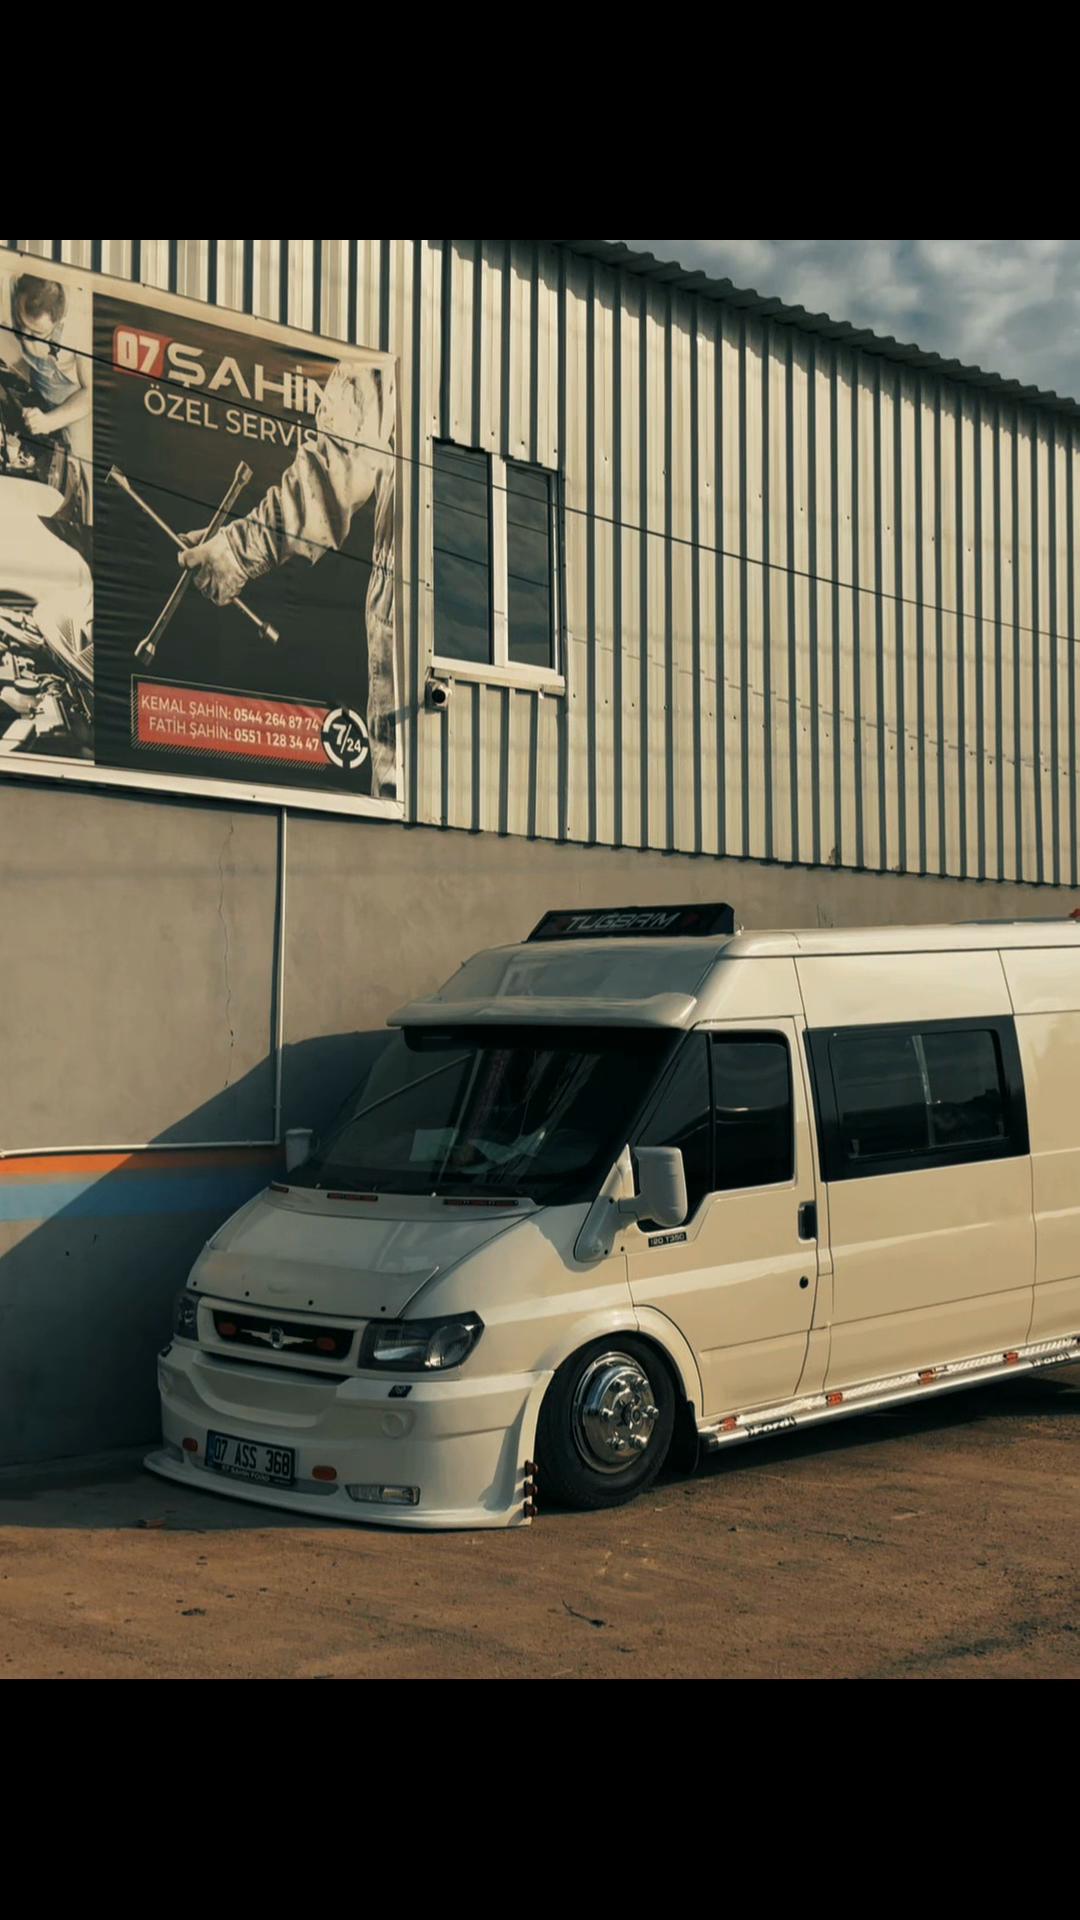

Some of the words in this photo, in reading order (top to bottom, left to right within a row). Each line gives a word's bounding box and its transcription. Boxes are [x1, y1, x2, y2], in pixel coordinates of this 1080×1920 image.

[116, 330, 161, 374] 07
[143, 384, 219, 430] ÖZEL
[141, 695, 186, 714] KEMAL
[189, 700, 232, 722] ŞAHİN:
[234, 707, 262, 724] 0544
[265, 713, 286, 727] 264
[288, 715, 302, 729] 87
[305, 718, 320, 732] 74
[149, 715, 186, 733] FATİH
[189, 723, 232, 744] ŞAHİN:
[234, 730, 262, 745] 0551
[266, 733, 287, 748] 128
[289, 736, 304, 750] 34
[305, 738, 320, 752] 47
[214, 1437, 228, 1461] 07
[234, 1442, 257, 1469] ASS
[264, 1449, 290, 1476] 368
